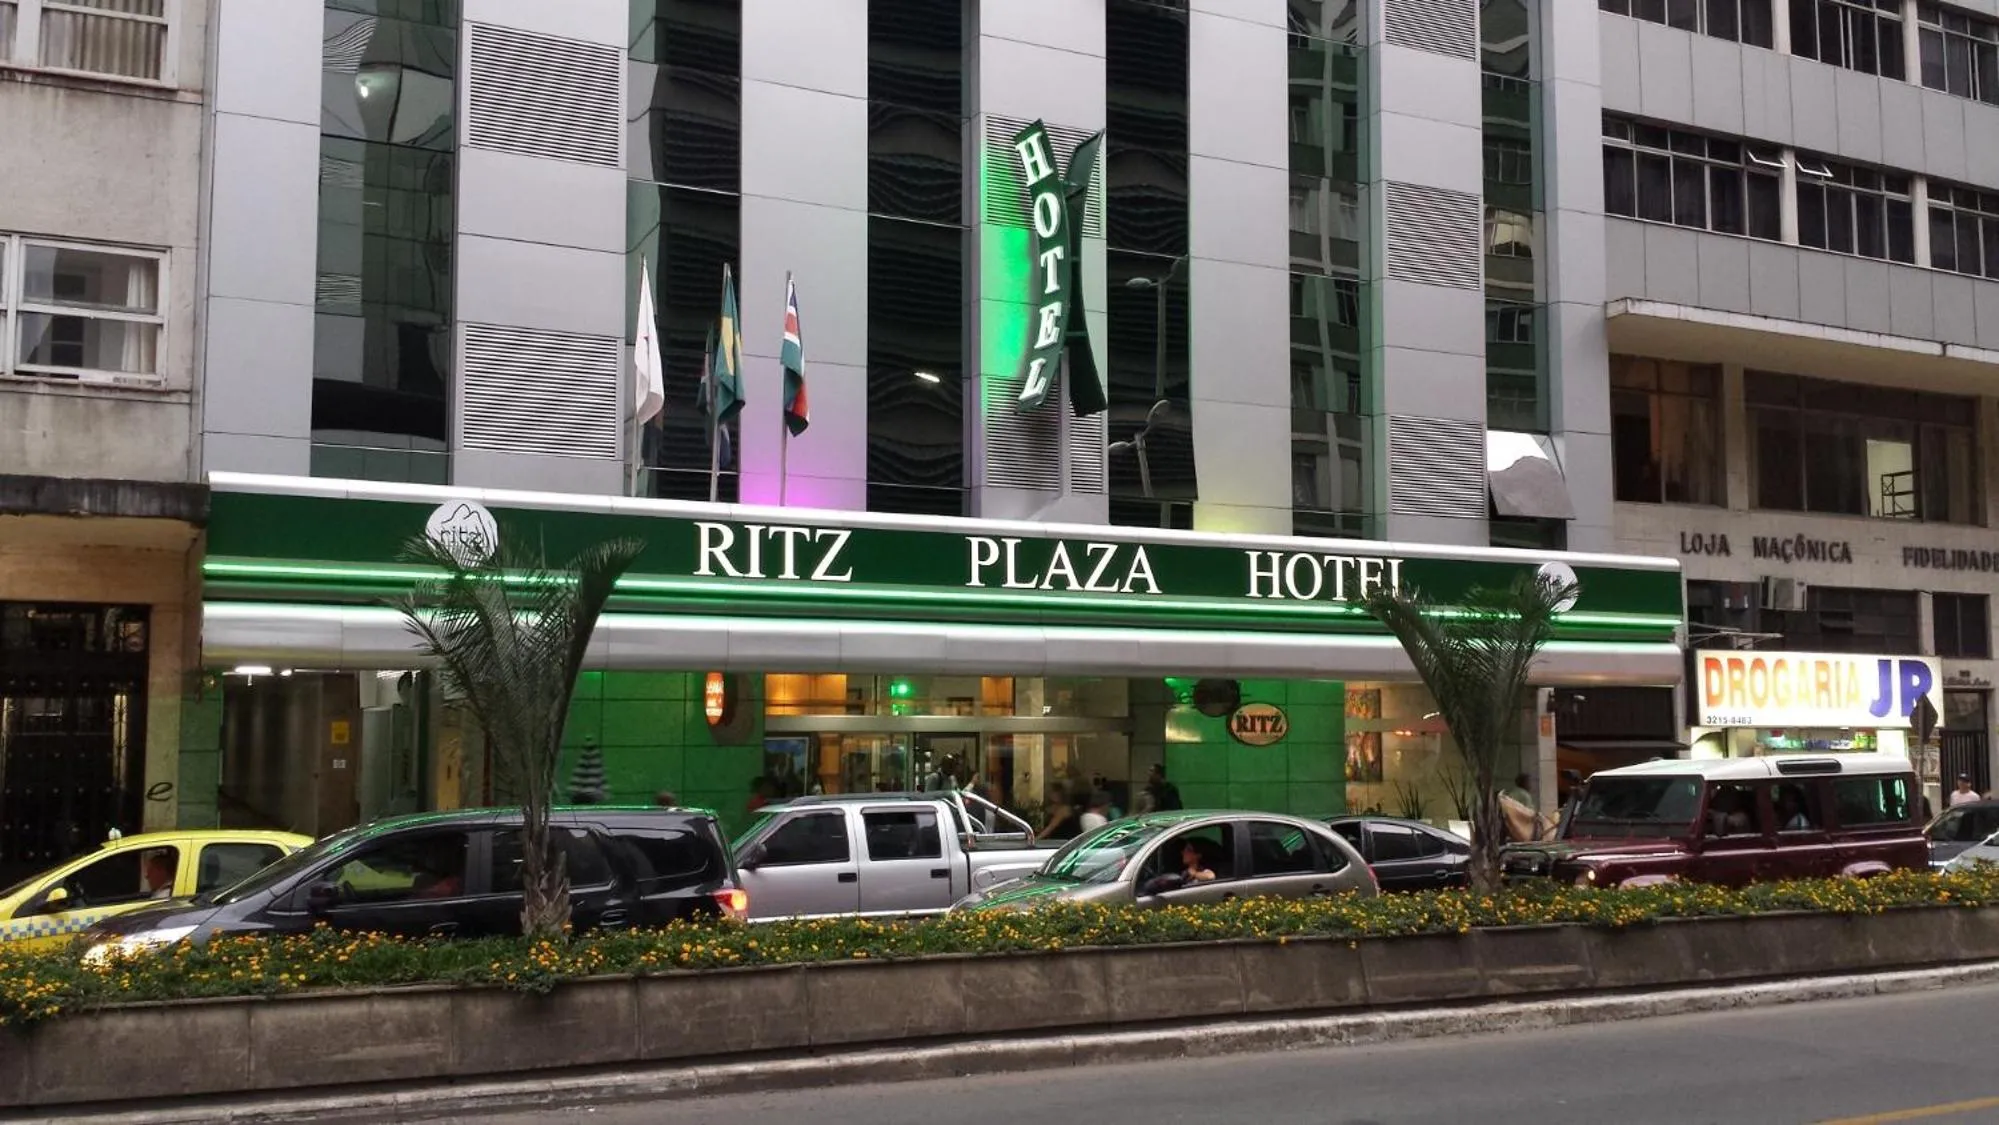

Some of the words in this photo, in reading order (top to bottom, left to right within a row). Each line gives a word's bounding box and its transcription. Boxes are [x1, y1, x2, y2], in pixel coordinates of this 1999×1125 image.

[1015, 131, 1061, 401] HOTEL
[693, 522, 853, 582] RITZ
[965, 536, 1162, 594] PLAZA
[1680, 532, 1731, 557] LOJA
[1753, 534, 1853, 564] MAÇÔNICA
[1705, 657, 1862, 709] DROGARIA
[1236, 714, 1283, 733] RITZ
